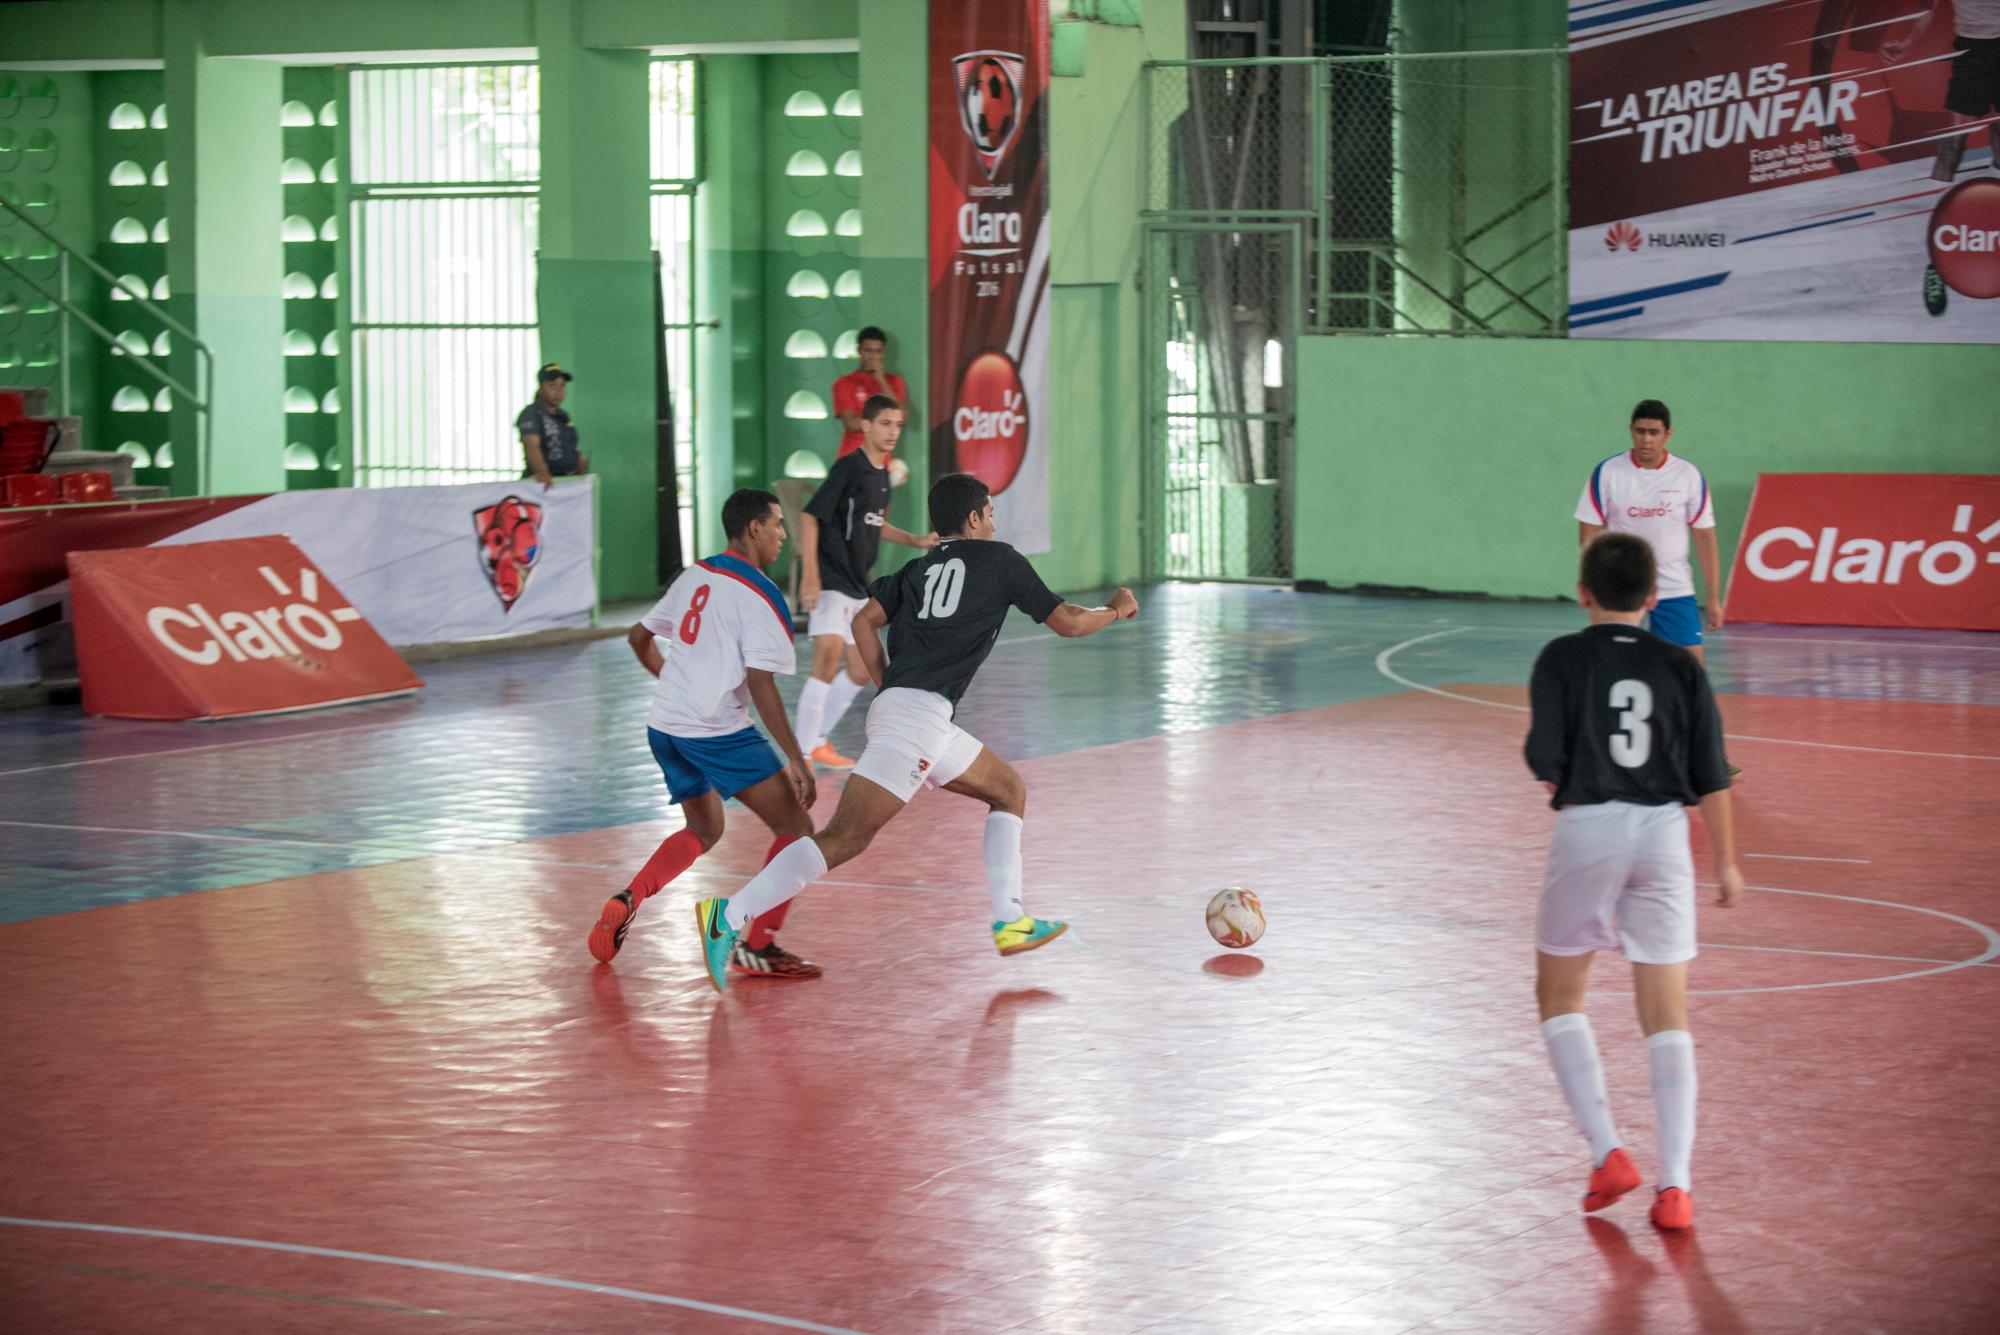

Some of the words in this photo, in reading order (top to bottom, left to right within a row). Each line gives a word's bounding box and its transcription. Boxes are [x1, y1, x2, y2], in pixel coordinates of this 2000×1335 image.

[1601, 93, 1641, 128] LA
[1645, 72, 1743, 118] TAREA
[1747, 62, 1789, 98] ES
[1636, 80, 1860, 163] TRIUNFAR
[1749, 144, 1788, 163] Frank
[1789, 141, 1806, 155] de
[1807, 138, 1821, 151] la
[1822, 133, 1857, 148] Mota
[958, 202, 1021, 244] Claro
[1648, 233, 1726, 248] HUAWEI
[1934, 224, 2000, 252] Clar
[954, 259, 1024, 276] Futsal
[954, 405, 1015, 441] Claro
[1627, 505, 1666, 518] Claro
[1745, 526, 1977, 586] Claro
[917, 557, 966, 620] 10
[147, 601, 344, 666] Claro
[679, 583, 711, 646] 8
[1608, 678, 1653, 769] 3
